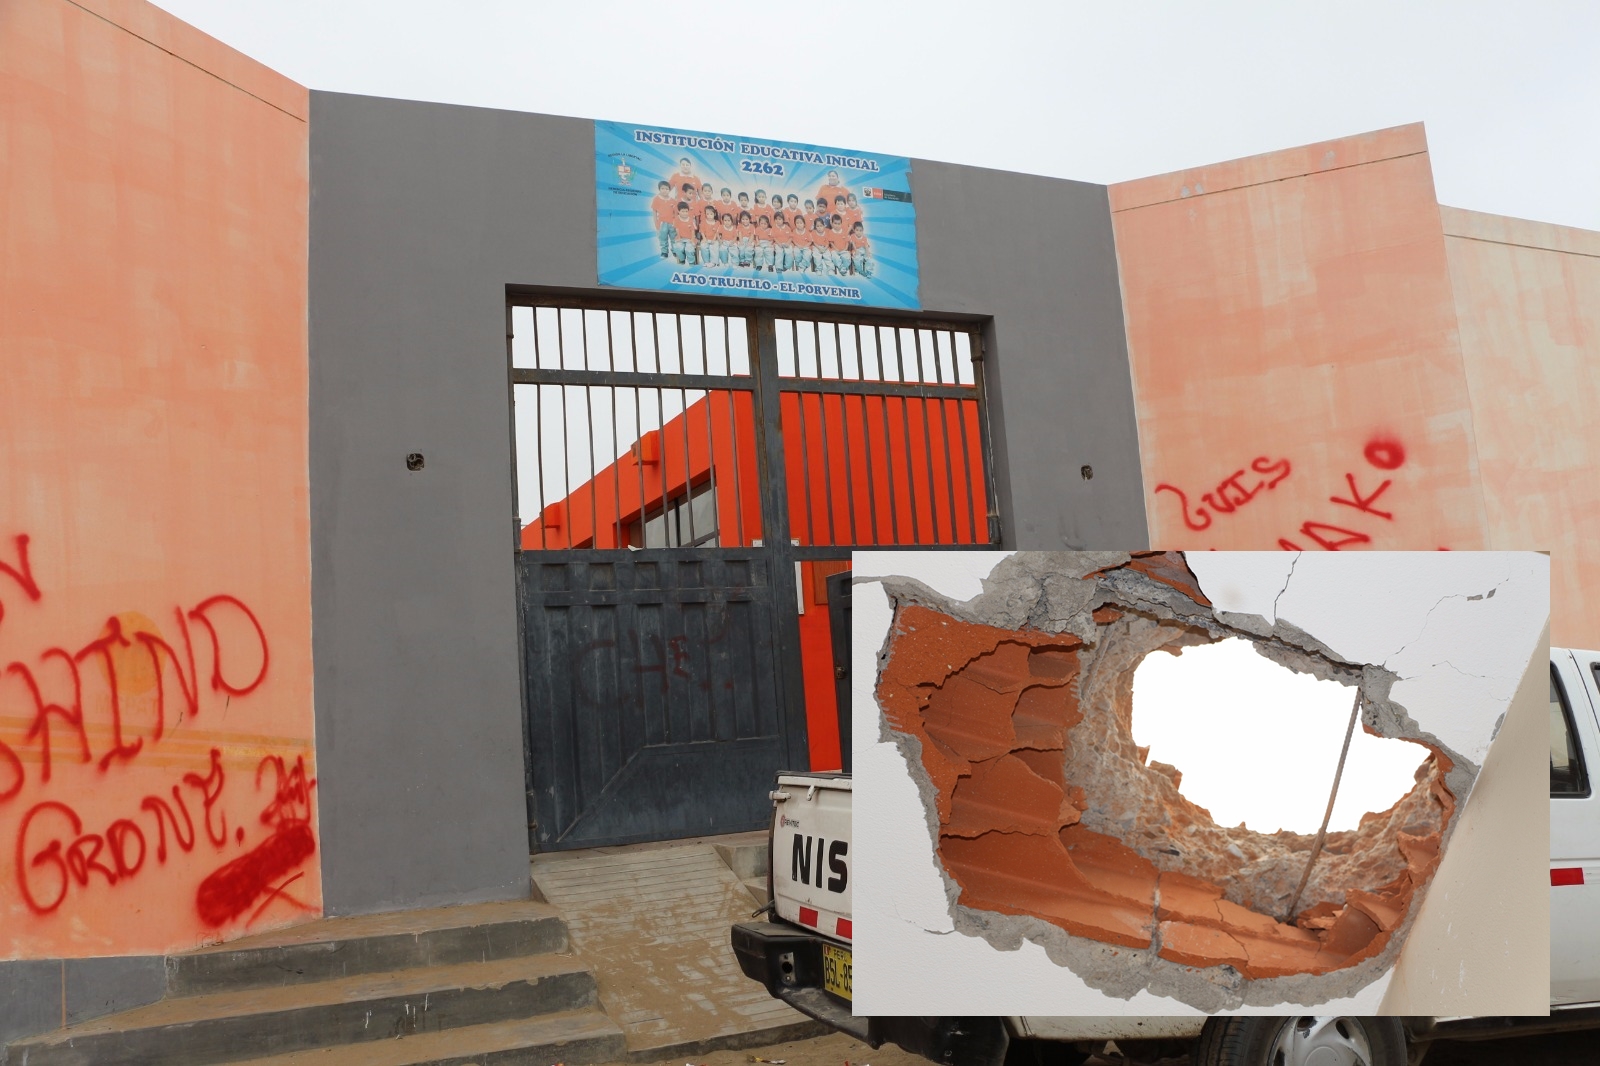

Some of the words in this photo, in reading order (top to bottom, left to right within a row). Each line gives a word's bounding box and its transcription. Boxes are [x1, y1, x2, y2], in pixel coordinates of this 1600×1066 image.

[635, 130, 734, 152] INSTITUCIÓN
[740, 144, 823, 164] EDUCATIVA
[826, 155, 879, 171] INICIAL
[741, 161, 783, 177] 2262
[672, 273, 706, 285] ALTO
[709, 276, 771, 290] TRUJILLO
[780, 282, 796, 292] EL
[798, 284, 860, 298] PORVENIR
